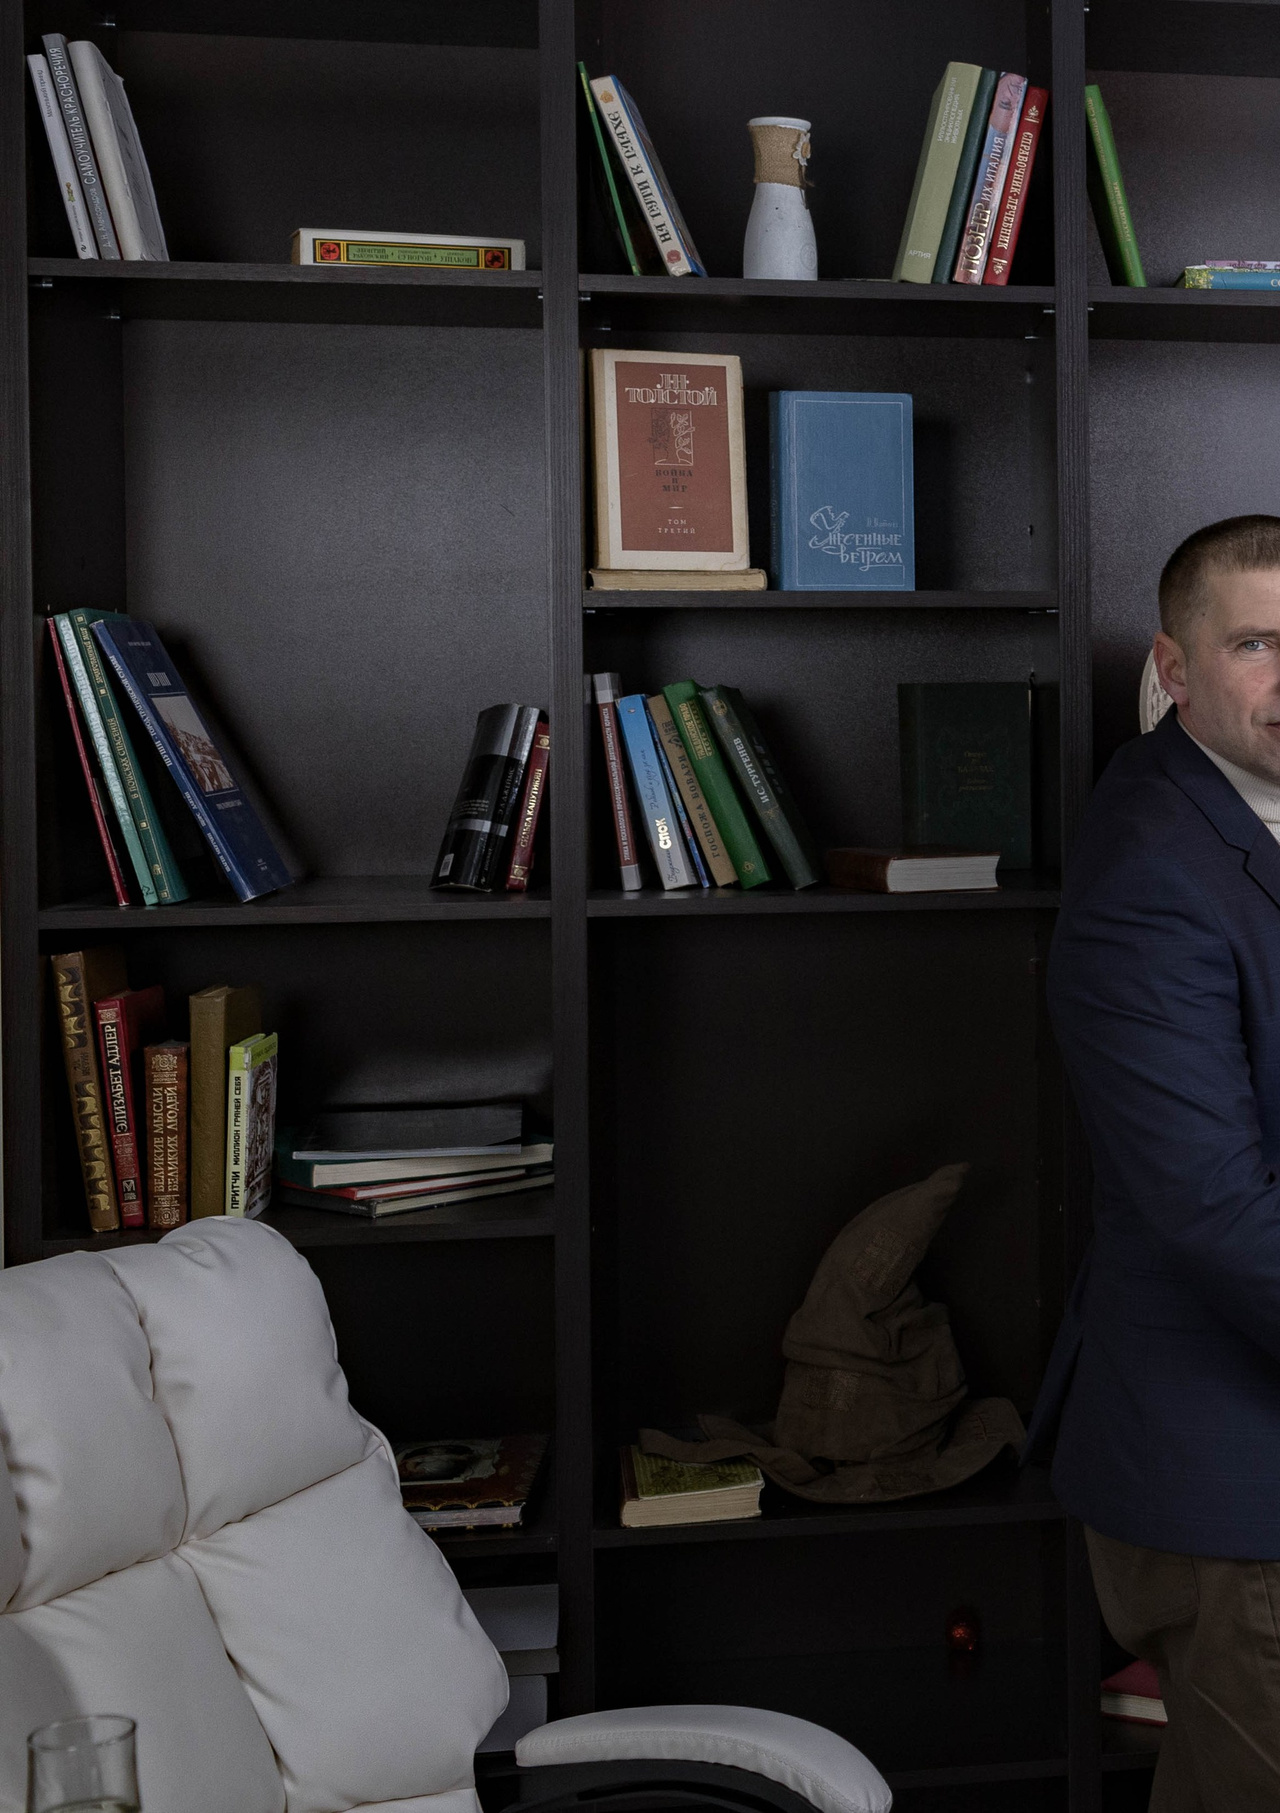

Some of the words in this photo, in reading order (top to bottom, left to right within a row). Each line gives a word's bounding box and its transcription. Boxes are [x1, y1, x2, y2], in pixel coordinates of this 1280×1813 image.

[50, 47, 80, 116] КРАСНОРЕЧИЯ
[69, 118, 96, 184] САМОУЧИТЕЛЬ
[985, 137, 1004, 183] ИТАЛИЯ
[655, 221, 672, 243] НА
[961, 203, 991, 274] ПОЗНЕР
[908, 249, 931, 259] АРТИЯ
[625, 387, 718, 406] ТОЛСТОЙ
[656, 468, 693, 477] ВОЙНА
[662, 484, 688, 493] МИР
[658, 526, 696, 534] ТРЕТИЙ
[109, 655, 124, 679] СУДЬБЫ
[122, 677, 147, 718] ТРАГИЧЕСКОЙ
[678, 703, 692, 722] ПРАВО
[143, 716, 157, 736] ГОРОД
[602, 707, 611, 727] ЮРИСТА
[107, 717, 126, 757] СПАСЕНИЯ
[155, 739, 173, 767] ШУШИ
[604, 727, 616, 761] ДЕЯТЕЛЬНОСТИ
[685, 721, 705, 760] ГРАЖДАНСКОЕ
[701, 731, 713, 757] ЧАСТЬ
[120, 757, 137, 792] ПОИСКАХ
[678, 755, 699, 799] БОВАРИ
[733, 737, 765, 793] ТУРГЕНЕВ
[502, 767, 515, 801] ДЖЕЙМС
[527, 769, 542, 816] КАПУТИКЯН
[608, 760, 624, 810] ПРОФЕССИОНАЛЬНОЙ
[617, 809, 628, 841] ПСИХОЛОГИЯ
[696, 803, 720, 858] ГОСПОЖА
[623, 845, 631, 860] ЭТИКА
[104, 1024, 121, 1066] АДЛЕР
[109, 1067, 129, 1133] ЭЛИЗАБЕТ
[234, 1076, 242, 1096] СЕБЯ
[153, 1087, 164, 1135] МЫСЛИ
[166, 1085, 179, 1132] ЛЮДЕЙ
[234, 1098, 242, 1130] ГРАНЕЙ
[153, 1135, 165, 1193] ВЕЛИКИЕ
[167, 1136, 179, 1193] ВЕЛИКИХ
[233, 1131, 241, 1166] МИЛЛИОН
[231, 1171, 240, 1209] ПРИТЧИ
